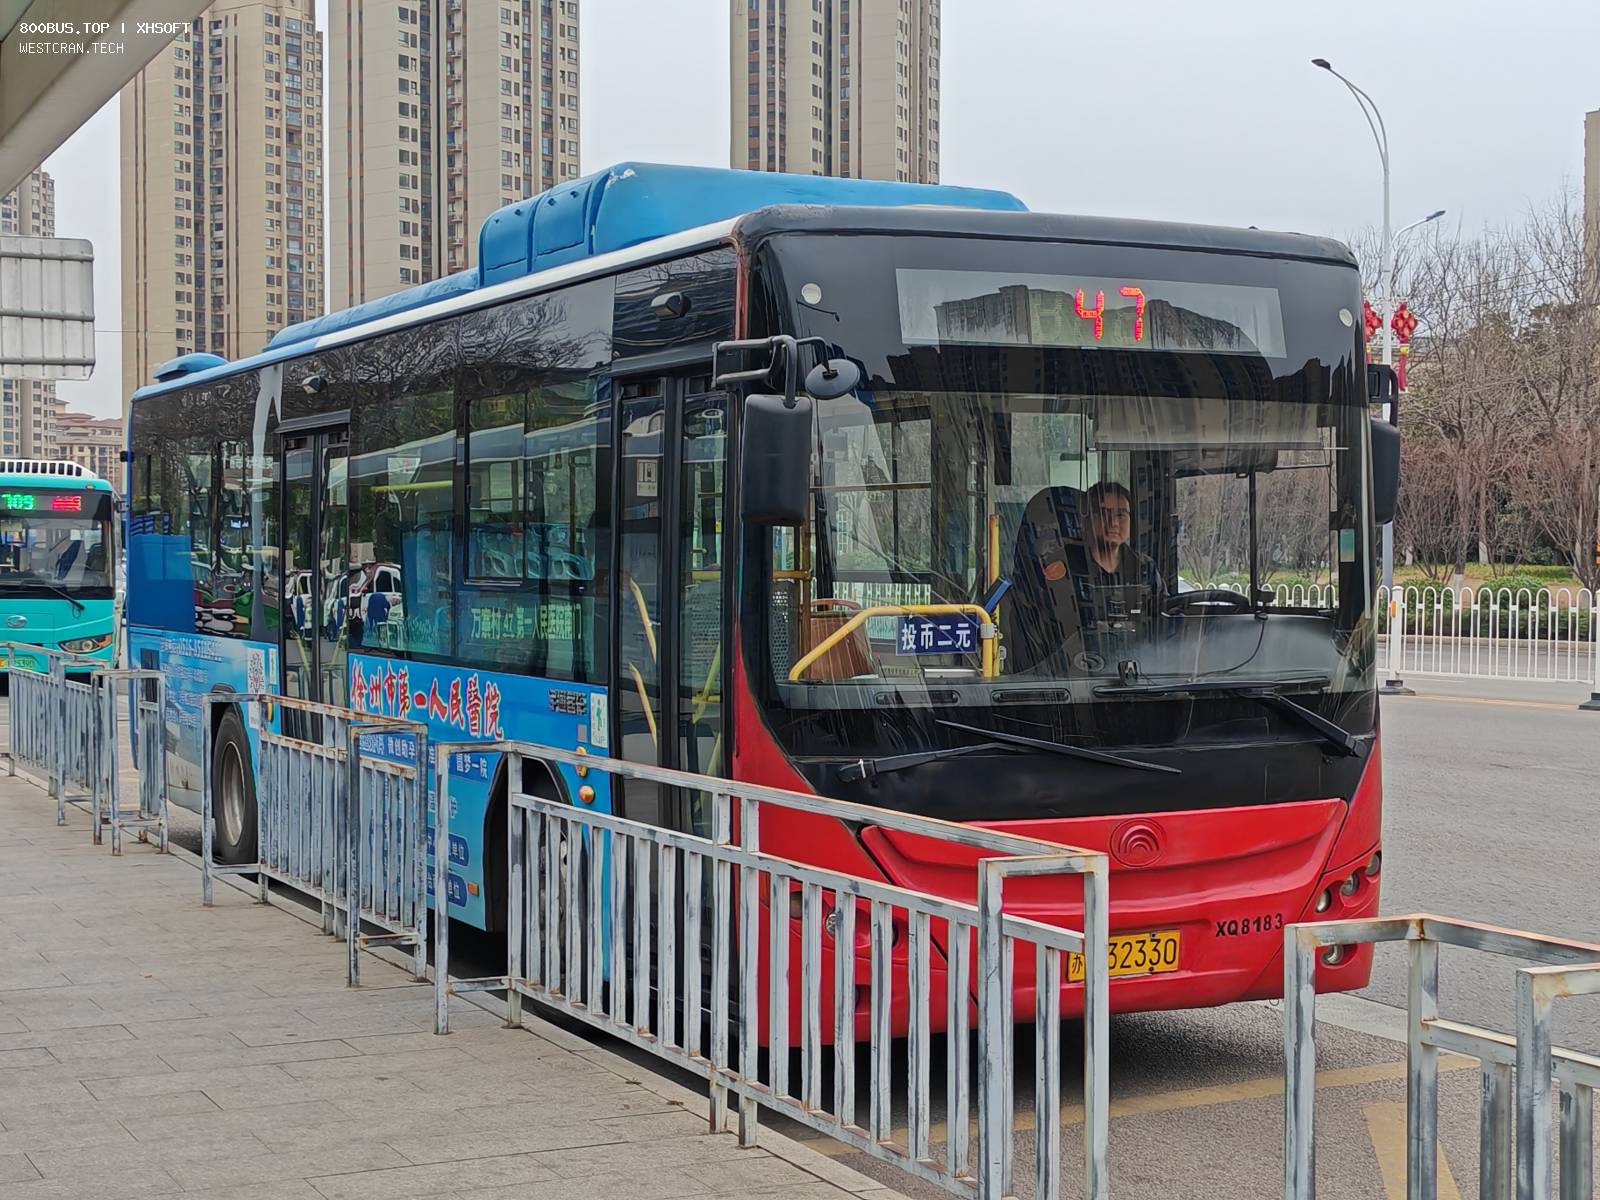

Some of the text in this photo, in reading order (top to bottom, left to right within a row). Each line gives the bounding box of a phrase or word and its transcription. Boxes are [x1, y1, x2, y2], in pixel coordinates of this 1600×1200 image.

[1074, 287, 1145, 341] 47
[901, 622, 971, 650] 投币二元
[1215, 913, 1283, 938] XQ8183
